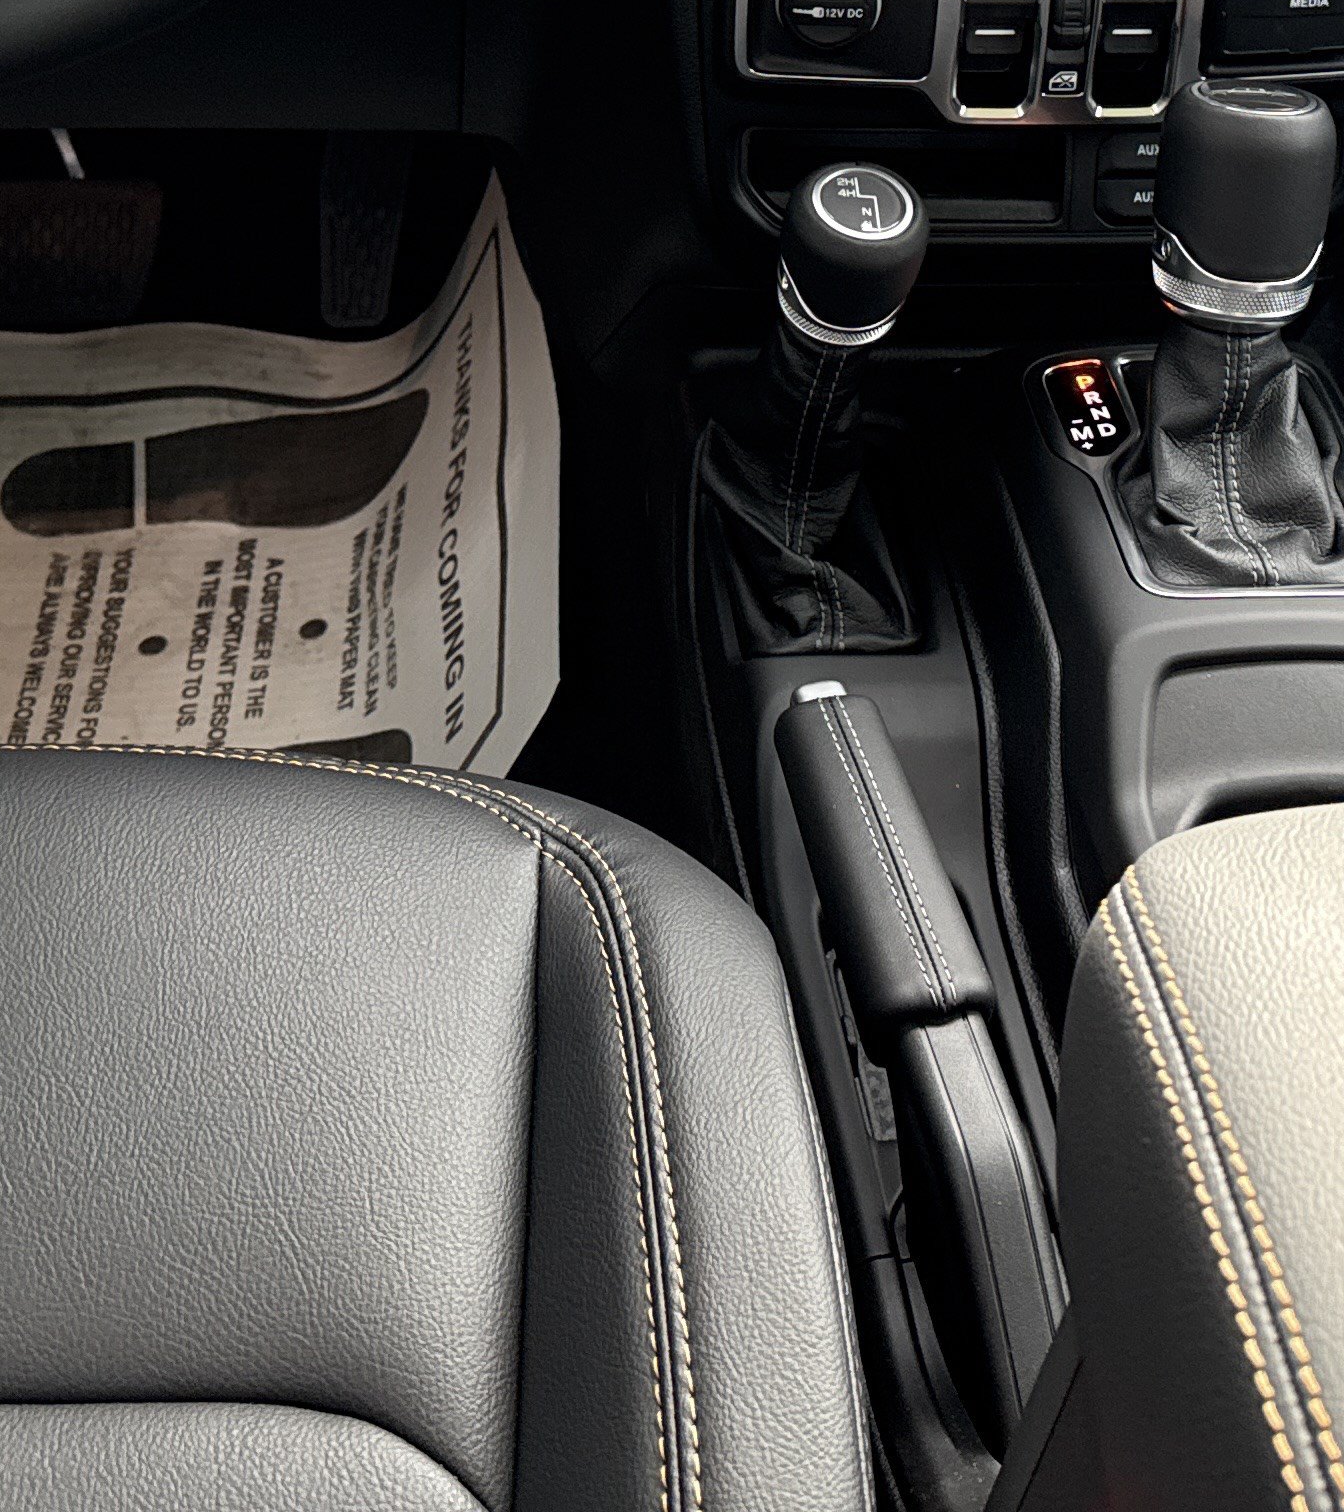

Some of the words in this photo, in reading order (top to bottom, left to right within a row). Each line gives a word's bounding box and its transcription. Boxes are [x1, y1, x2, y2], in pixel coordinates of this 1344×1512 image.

[825, 7, 844, 18] 12V
[847, 7, 864, 18] DC
[837, 178, 854, 186] 2H
[838, 188, 856, 197] 4H
[862, 207, 872, 216] N
[451, 312, 473, 451] THANKS
[1076, 376, 1094, 389] P
[1084, 392, 1103, 404] R
[1090, 407, 1111, 421] N
[1098, 423, 1116, 437] D
[1070, 427, 1094, 441] M
[441, 446, 468, 529] FOR
[46, 552, 71, 589] ARE
[109, 547, 136, 594] YOUR
[204, 560, 224, 576] IN
[233, 538, 258, 583] MOST
[267, 557, 284, 571] A
[197, 576, 220, 610] THE
[438, 528, 465, 691] COMING
[29, 590, 59, 659] ALWAYS
[217, 585, 250, 678] IMPORTANT
[255, 572, 283, 661] CUSTOMER
[83, 596, 125, 715] SUGGESTIONS
[186, 610, 214, 673] WORLD
[341, 613, 362, 674] PAPER
[58, 644, 83, 680] OUR
[250, 665, 270, 682] IS
[181, 674, 202, 699] TO
[244, 684, 267, 719] THE
[337, 673, 357, 711] MAT
[364, 651, 380, 718] CLEAN
[176, 702, 198, 733] US.
[445, 692, 464, 744] IN
